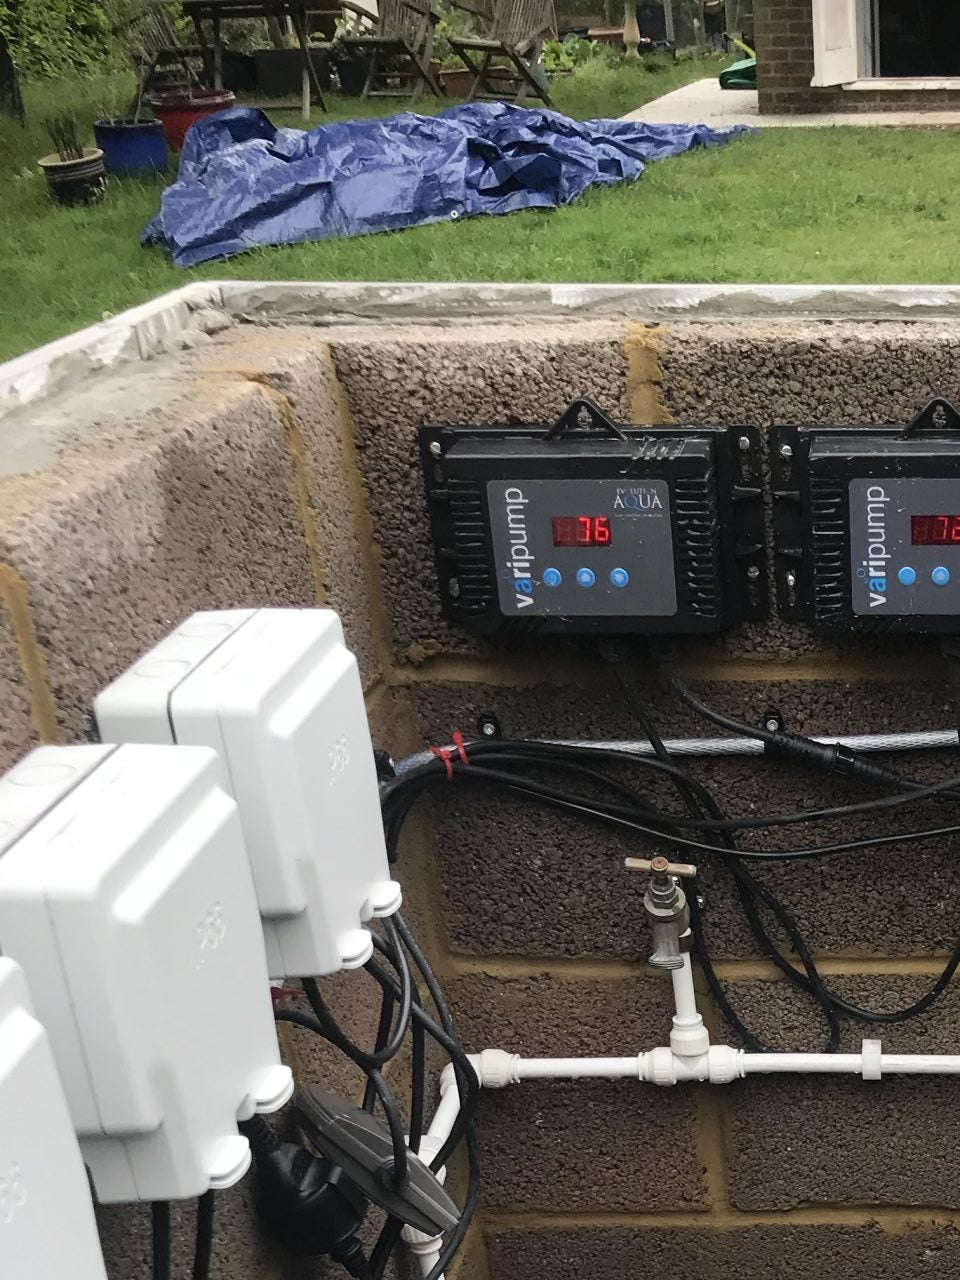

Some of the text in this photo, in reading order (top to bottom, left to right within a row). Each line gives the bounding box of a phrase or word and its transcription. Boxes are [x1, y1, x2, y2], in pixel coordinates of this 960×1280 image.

[505, 487, 535, 609] varipump
[613, 494, 663, 511] AQUA
[862, 486, 892, 608] varipump
